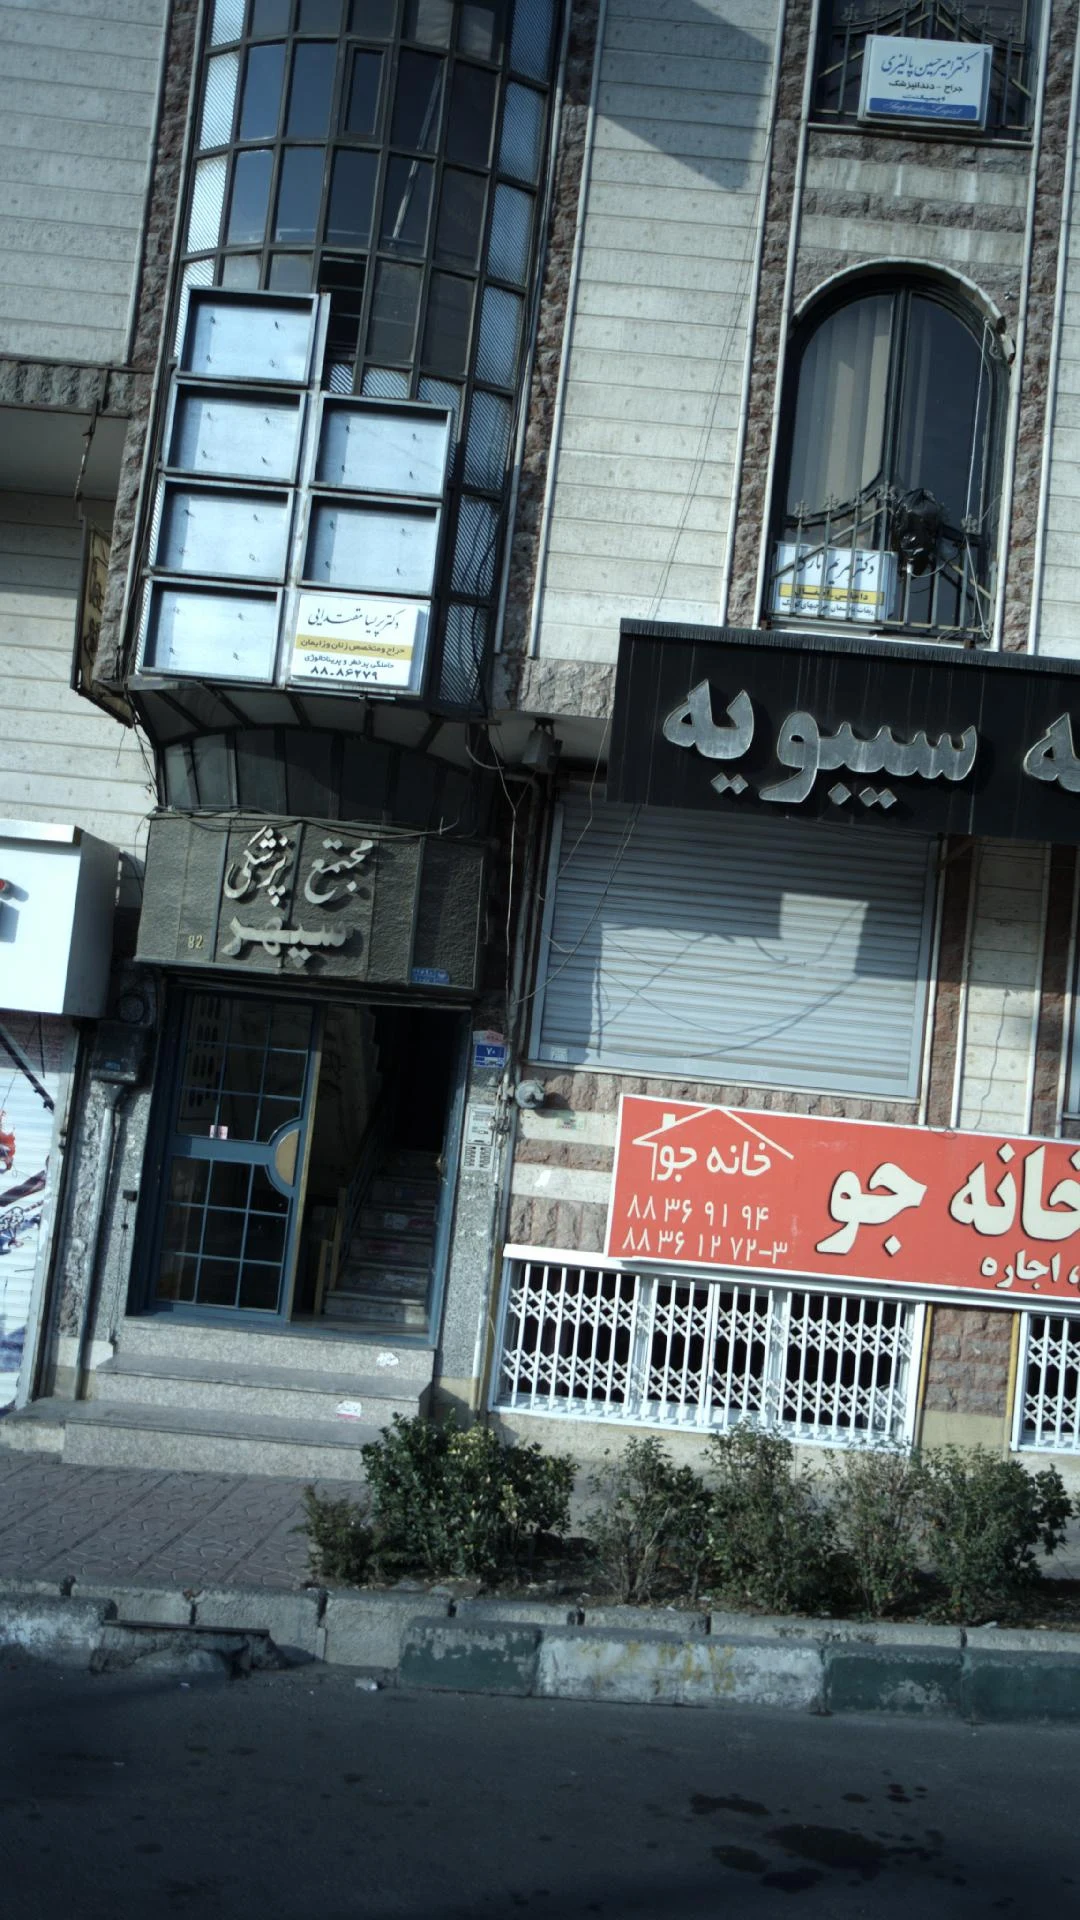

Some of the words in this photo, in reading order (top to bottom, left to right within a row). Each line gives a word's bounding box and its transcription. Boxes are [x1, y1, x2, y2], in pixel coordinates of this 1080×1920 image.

[946, 51, 980, 79] دکتر
[943, 84, 963, 94] جراح
[825, 558, 852, 584] ریم
[365, 614, 384, 637] پریسا
[380, 608, 406, 631] دکتر
[331, 641, 349, 650] زنان
[387, 647, 405, 655] جراح
[310, 665, 378, 680] ۸۸۰۸۶۲۷۹
[663, 678, 977, 809] سیبویه
[304, 839, 373, 904] مجتمع
[657, 1144, 697, 1183] جو
[706, 1140, 771, 1177] خانه
[949, 1142, 1080, 1241] خانه
[815, 1162, 927, 1256] جو
[980, 1249, 1060, 1290] اجاره
